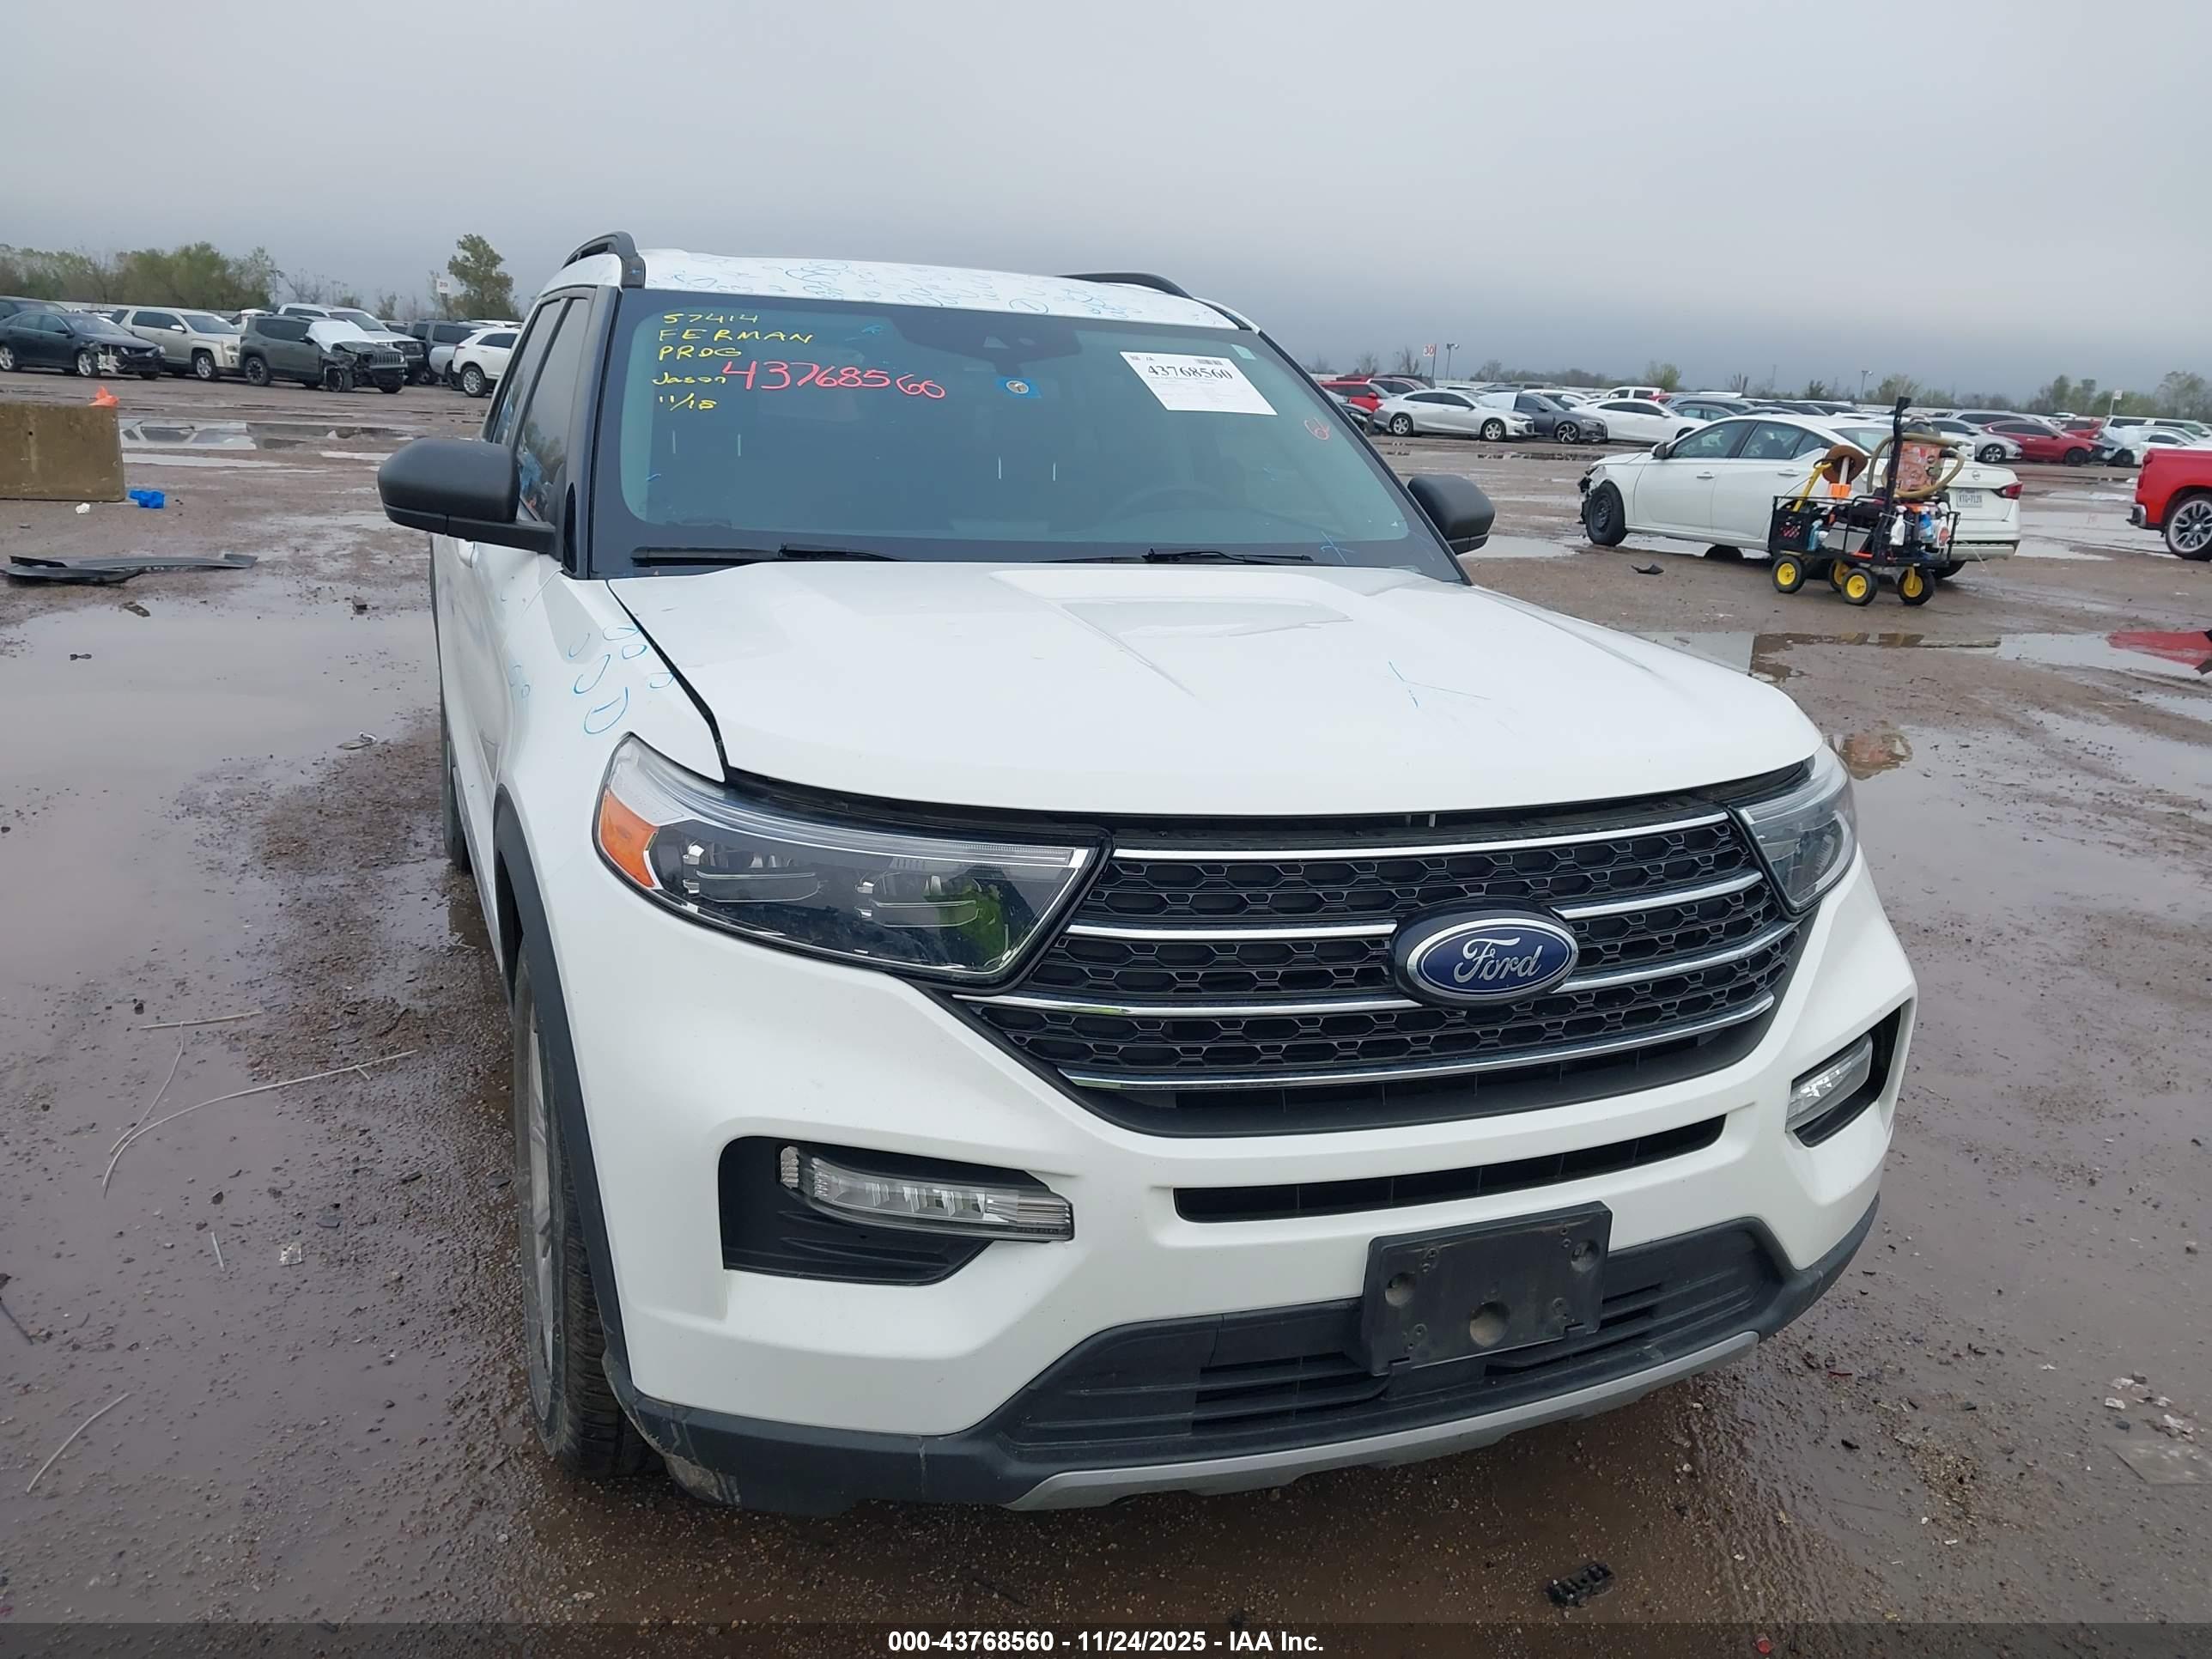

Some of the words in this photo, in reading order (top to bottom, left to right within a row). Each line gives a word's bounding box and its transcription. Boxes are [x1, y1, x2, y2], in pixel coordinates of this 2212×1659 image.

[663, 313, 758, 324] 57414
[659, 328, 813, 343] FERMAN
[1424, 345, 1434, 356] 30
[652, 372, 726, 385] Jason
[1147, 365, 1233, 379] 43768560
[1453, 937, 1544, 983] Ford
